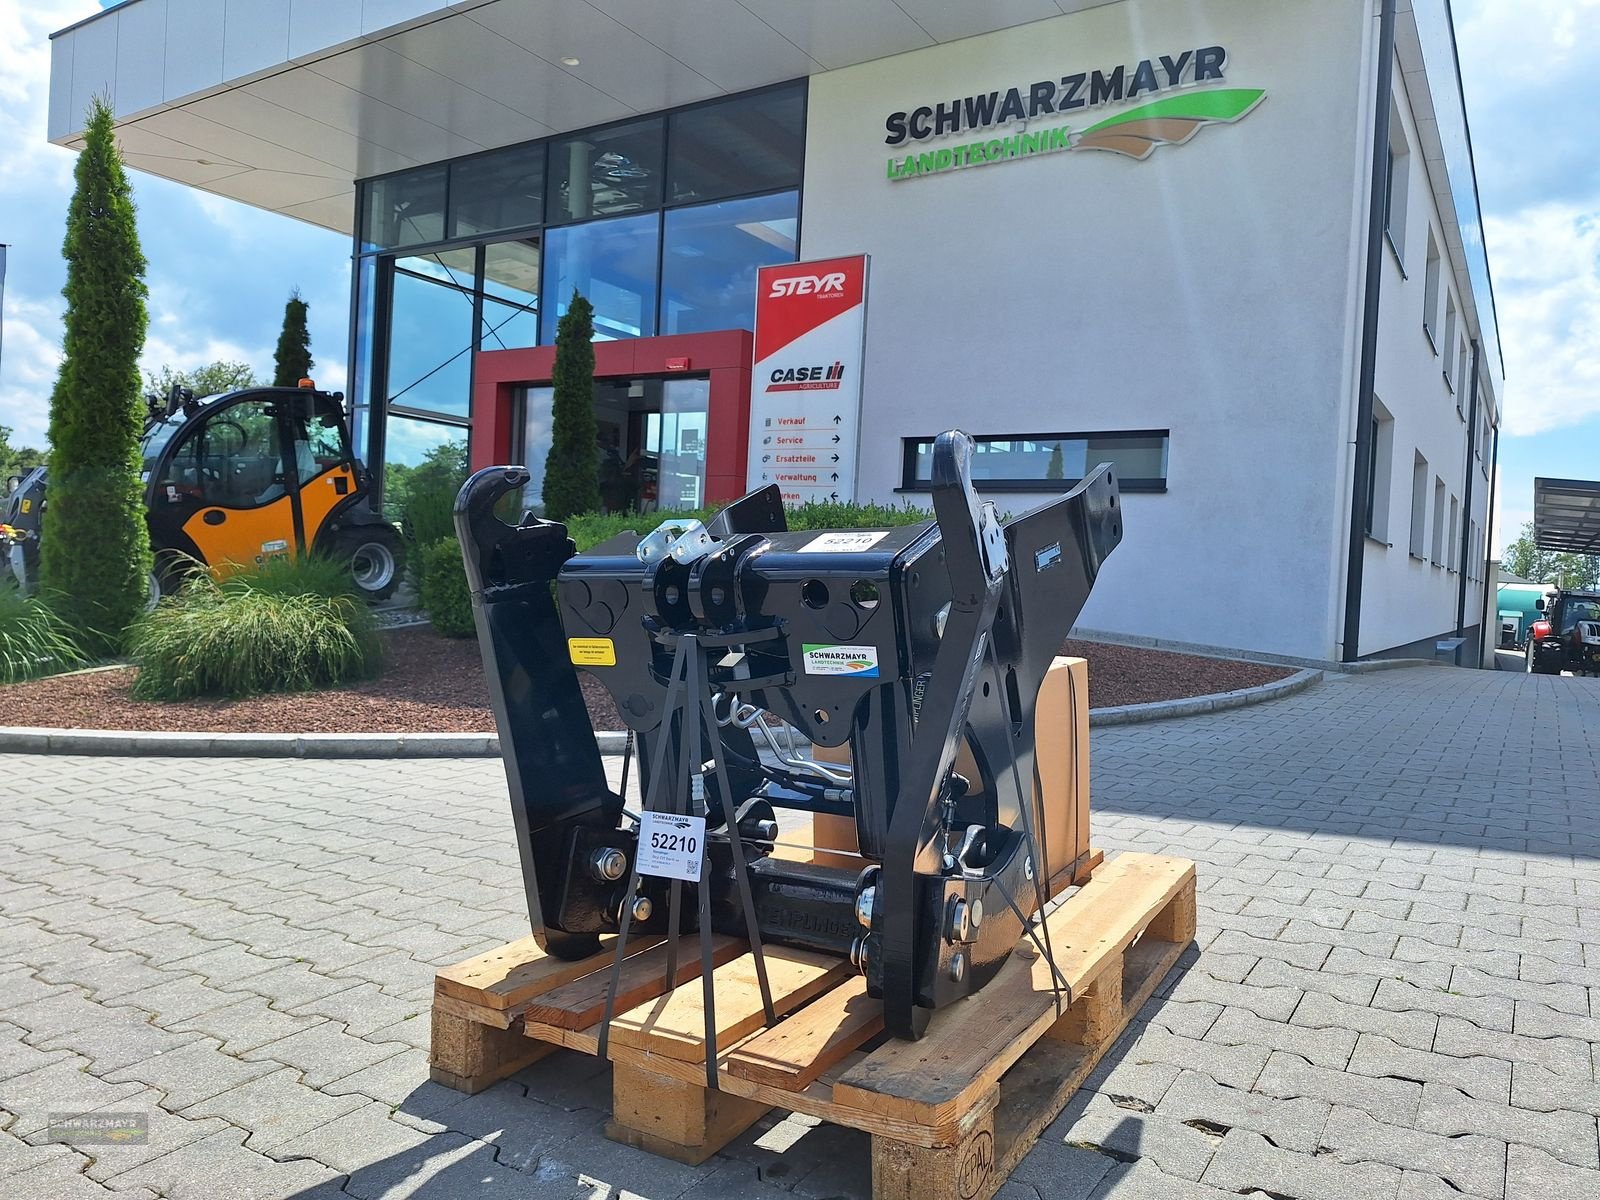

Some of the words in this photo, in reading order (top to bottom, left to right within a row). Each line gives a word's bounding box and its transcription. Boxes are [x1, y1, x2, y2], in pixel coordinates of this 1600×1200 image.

[885, 46, 1226, 145] SCHWARZMAYR
[887, 125, 1071, 179] LANDTECHNIK
[769, 272, 846, 298] STEYR
[770, 366, 823, 383] CASE
[799, 381, 839, 389] AGRICULTURE
[778, 417, 806, 425] Verkauf
[776, 436, 804, 444] Service
[775, 455, 816, 463] Ersatzteile
[775, 473, 817, 483] Verwaltung
[809, 651, 867, 660] SCHWARZMAYR
[652, 813, 689, 823] SCHWARZMAYR
[651, 832, 697, 854] 52210
[964, 1141, 989, 1192] EPAL
